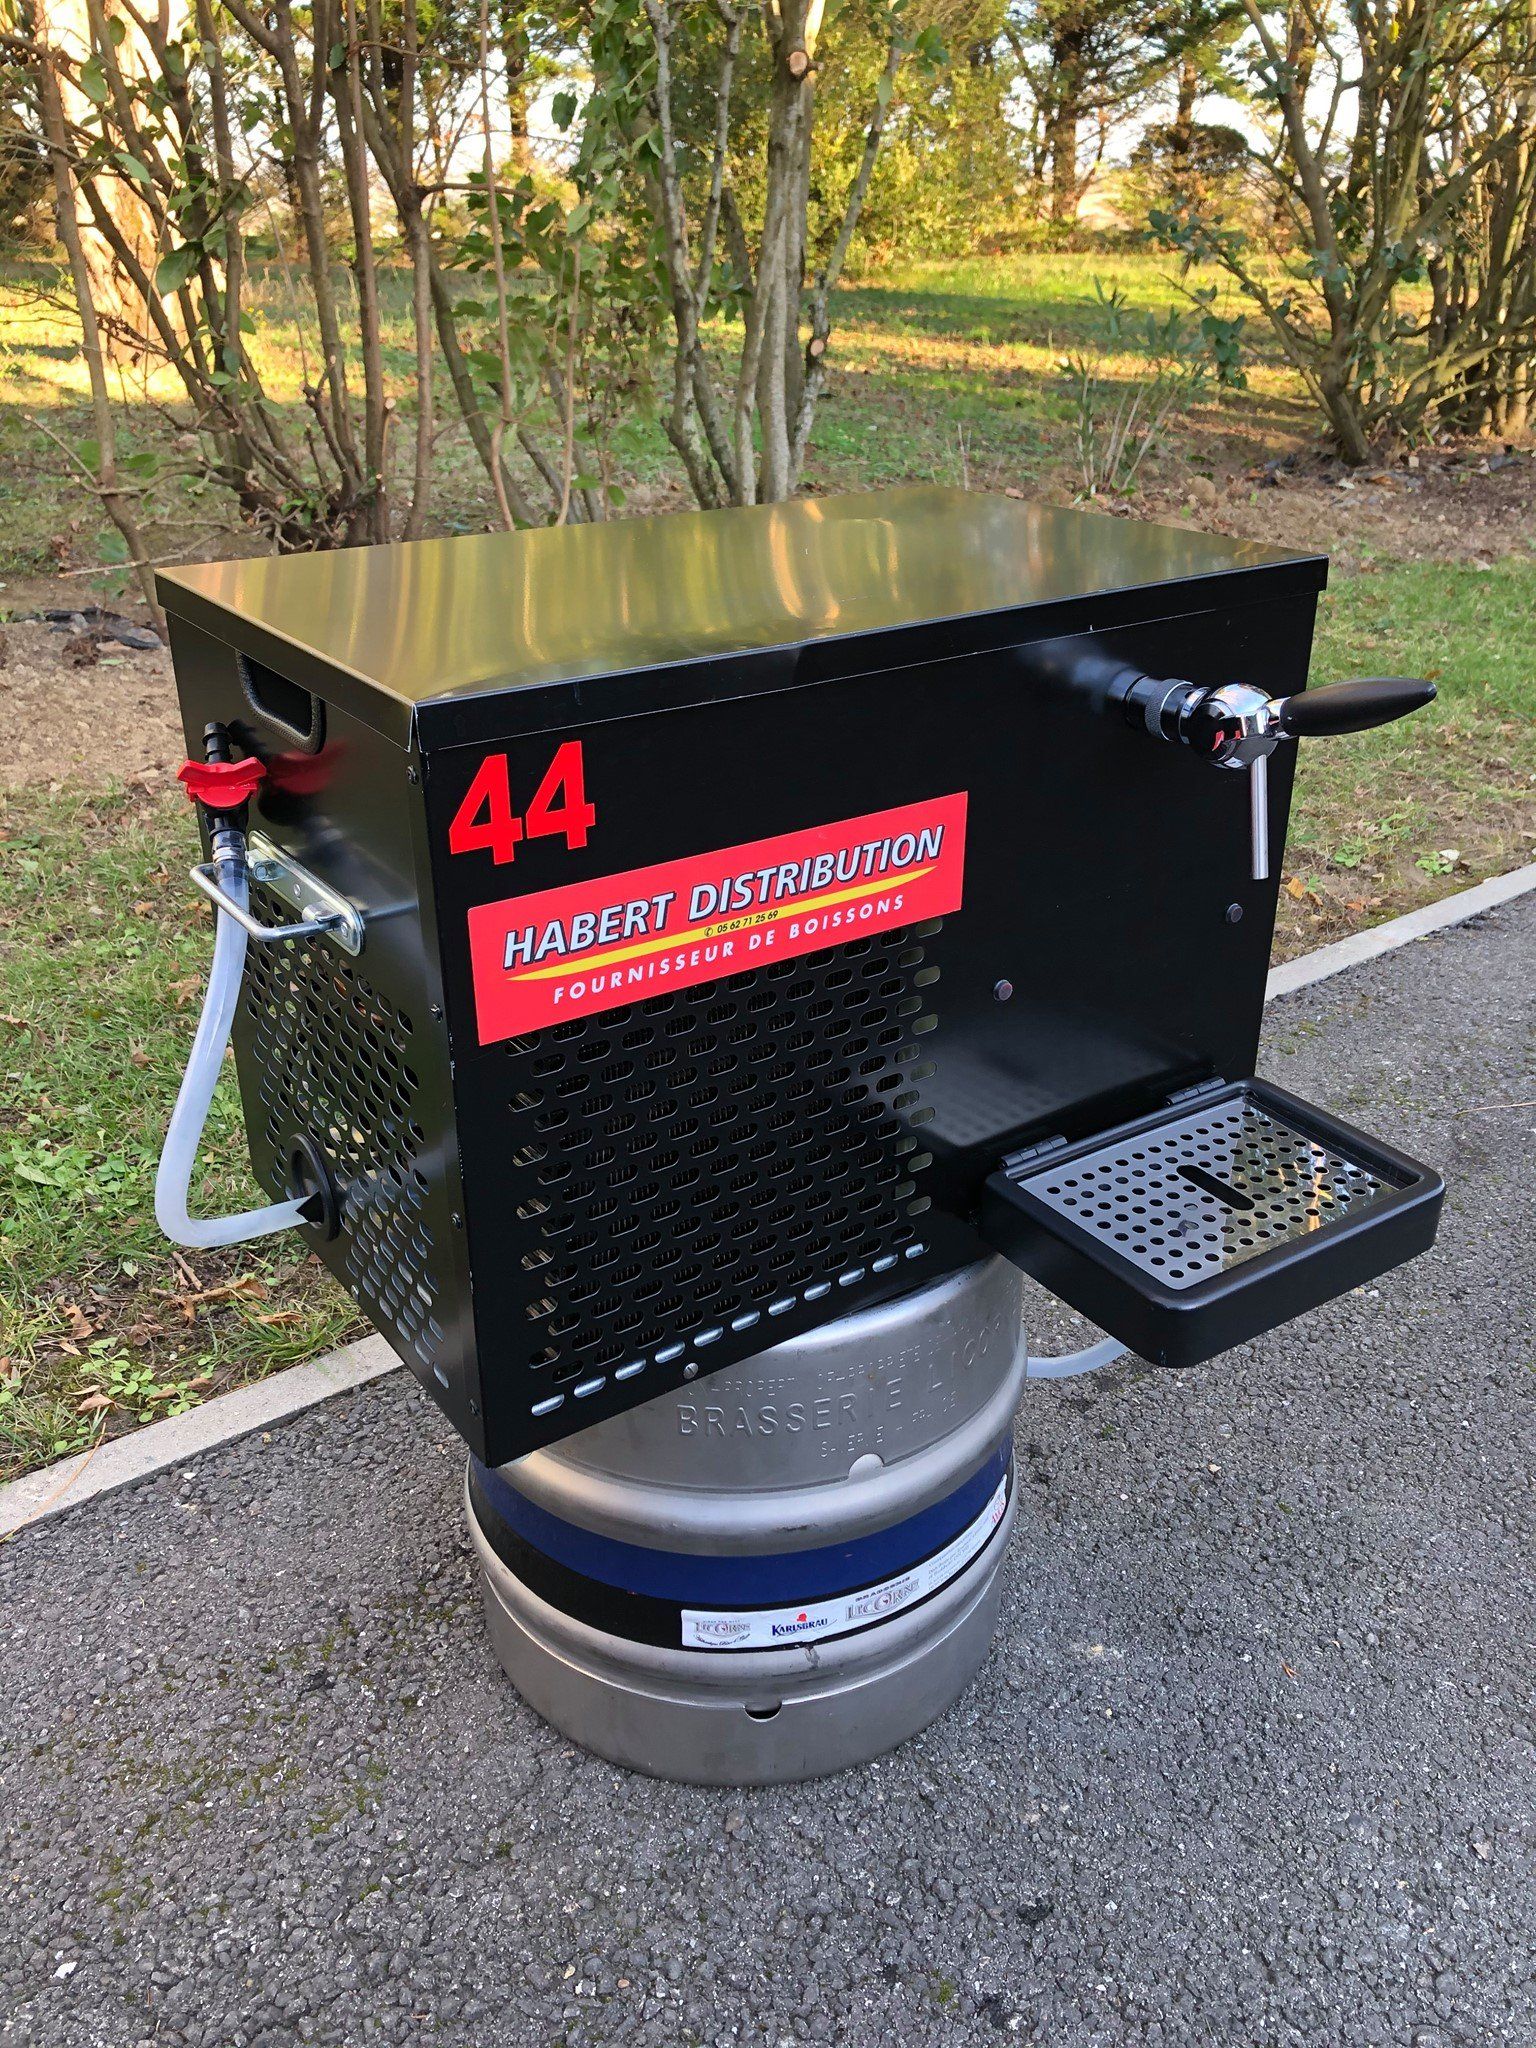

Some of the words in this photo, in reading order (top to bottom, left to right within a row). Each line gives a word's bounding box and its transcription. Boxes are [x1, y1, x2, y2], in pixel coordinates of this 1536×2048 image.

[449, 740, 596, 865] 44
[503, 892, 676, 970] HABERT
[688, 824, 944, 922] DISTRIBUTION
[553, 941, 734, 1005] FOURNISSEUR
[748, 929, 775, 951] DE
[788, 894, 904, 940] BOISSONS
[717, 923, 728, 934] 05
[729, 920, 741, 930] 62
[742, 917, 752, 927] 71
[755, 913, 766, 923] 25
[767, 910, 778, 920] 69
[677, 1377, 902, 1438] BRASSERIE
